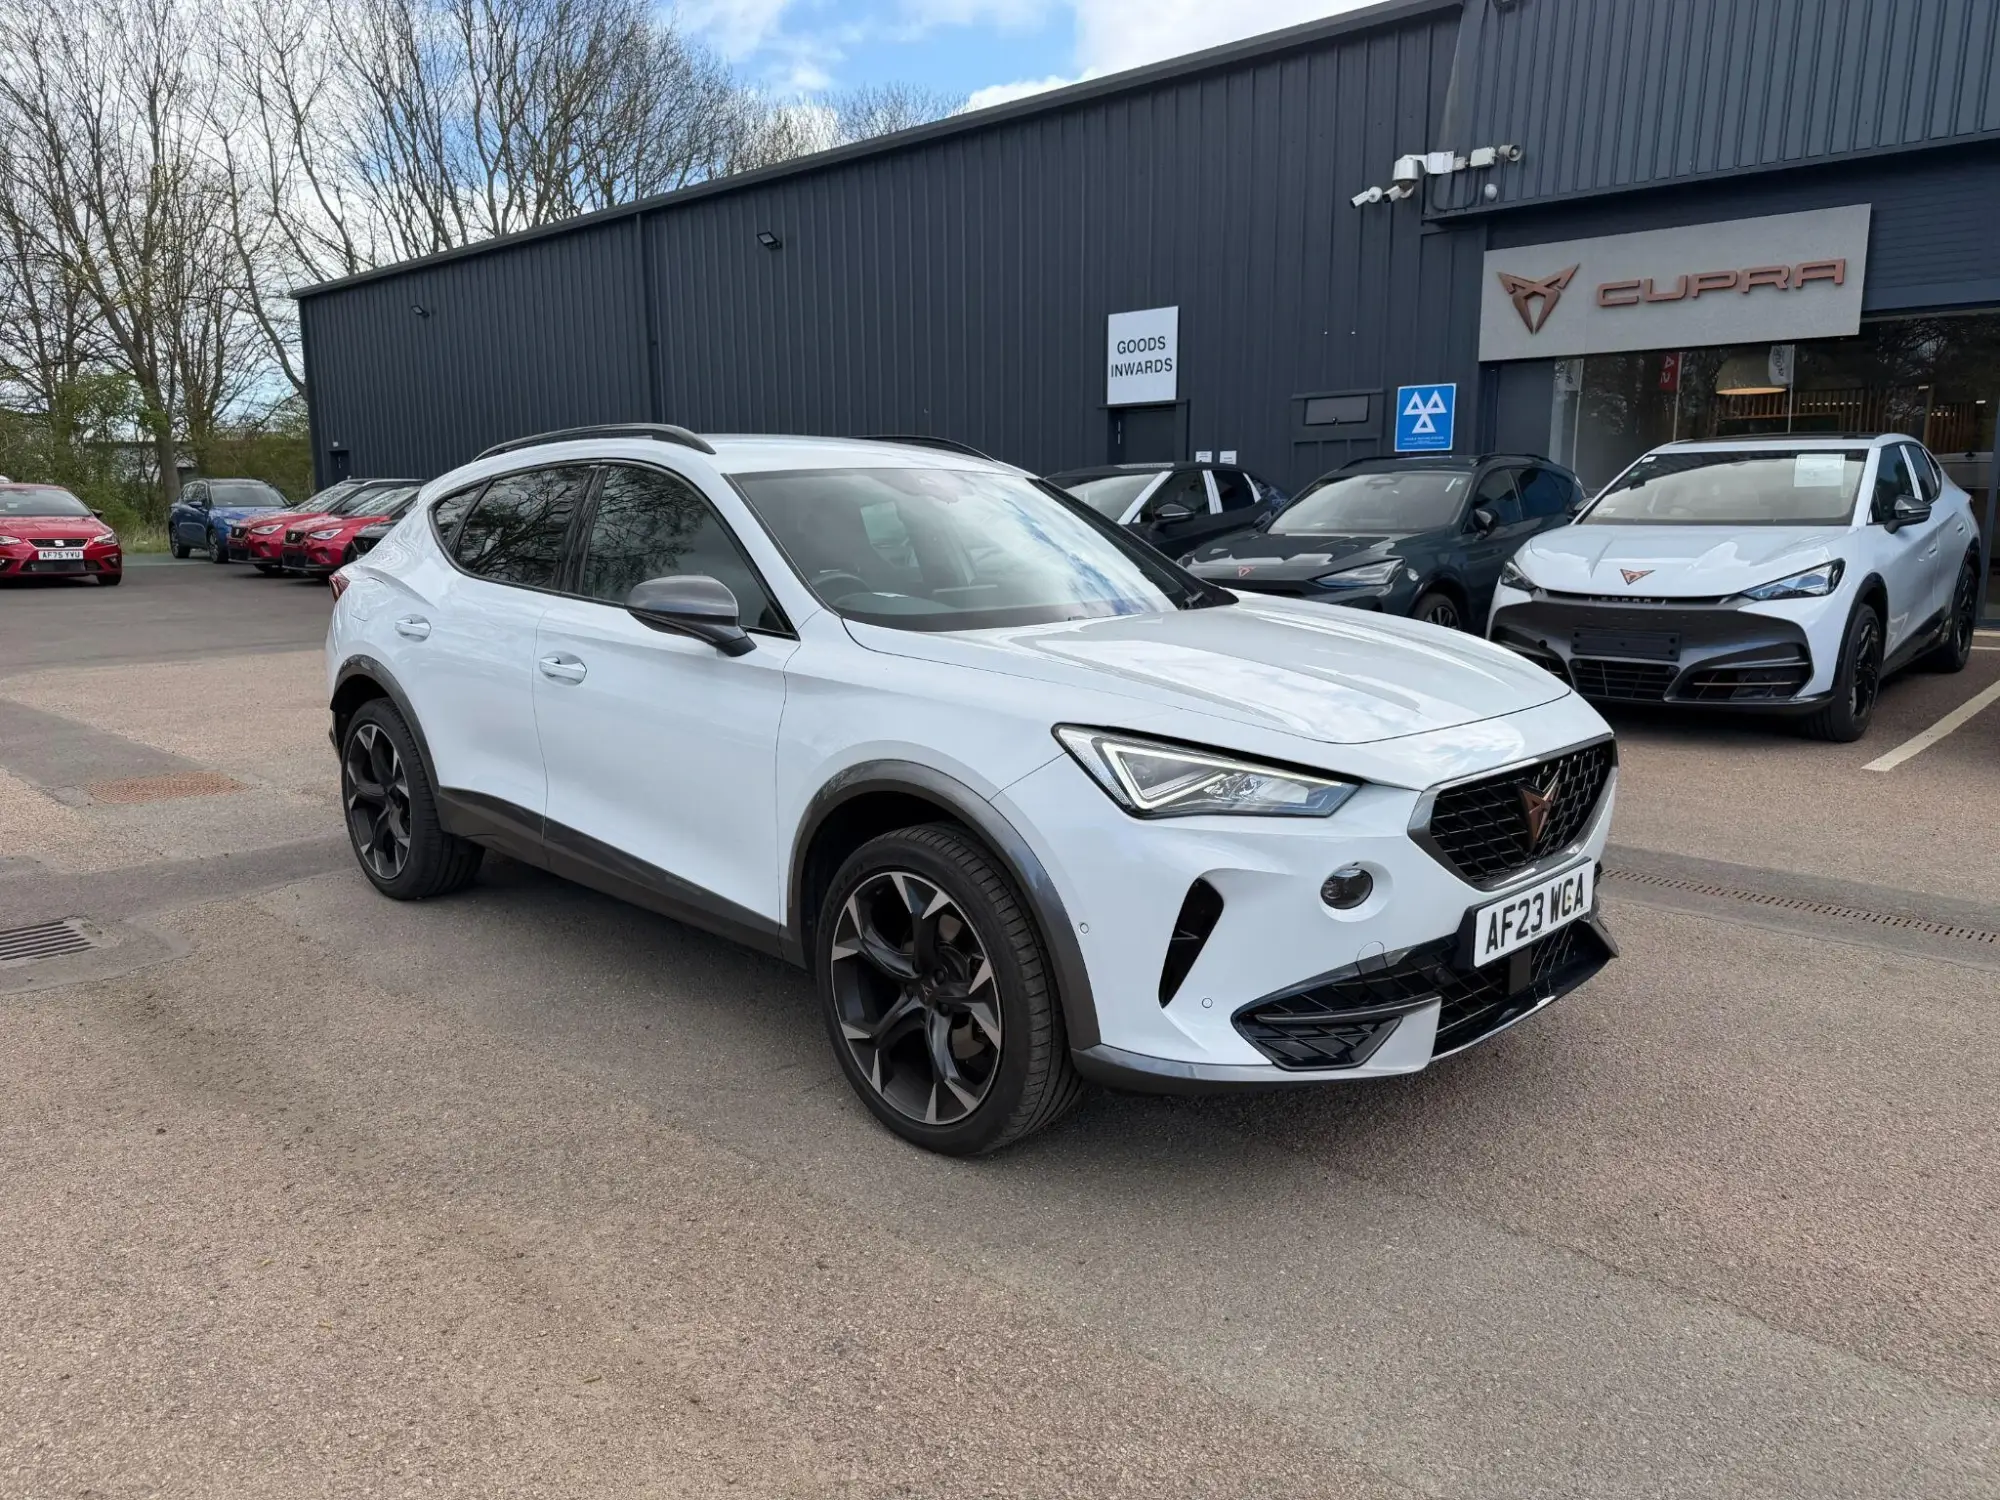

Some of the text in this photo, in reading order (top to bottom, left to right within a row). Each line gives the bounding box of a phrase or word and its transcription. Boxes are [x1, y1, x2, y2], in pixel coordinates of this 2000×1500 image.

[1597, 259, 1846, 307] CUPRA
[1117, 336, 1166, 354] GOODS
[1111, 358, 1173, 378] INWARDS
[1485, 873, 1583, 954] AF23 WCA
